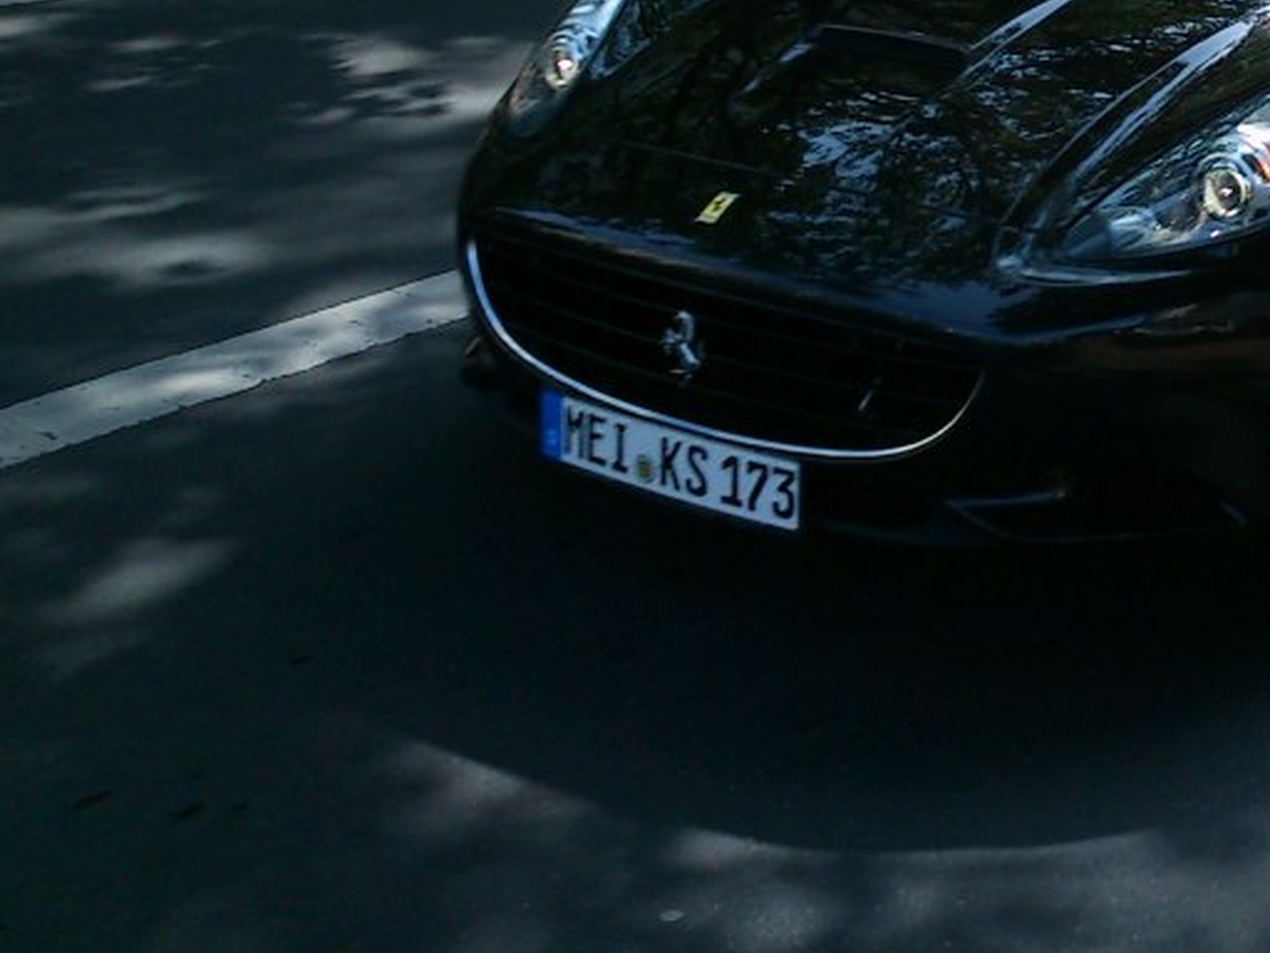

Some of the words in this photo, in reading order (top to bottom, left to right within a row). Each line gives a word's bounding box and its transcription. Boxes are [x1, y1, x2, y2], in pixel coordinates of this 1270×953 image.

[565, 405, 630, 474] MEI
[660, 435, 709, 498] KS
[719, 455, 797, 520] 173
